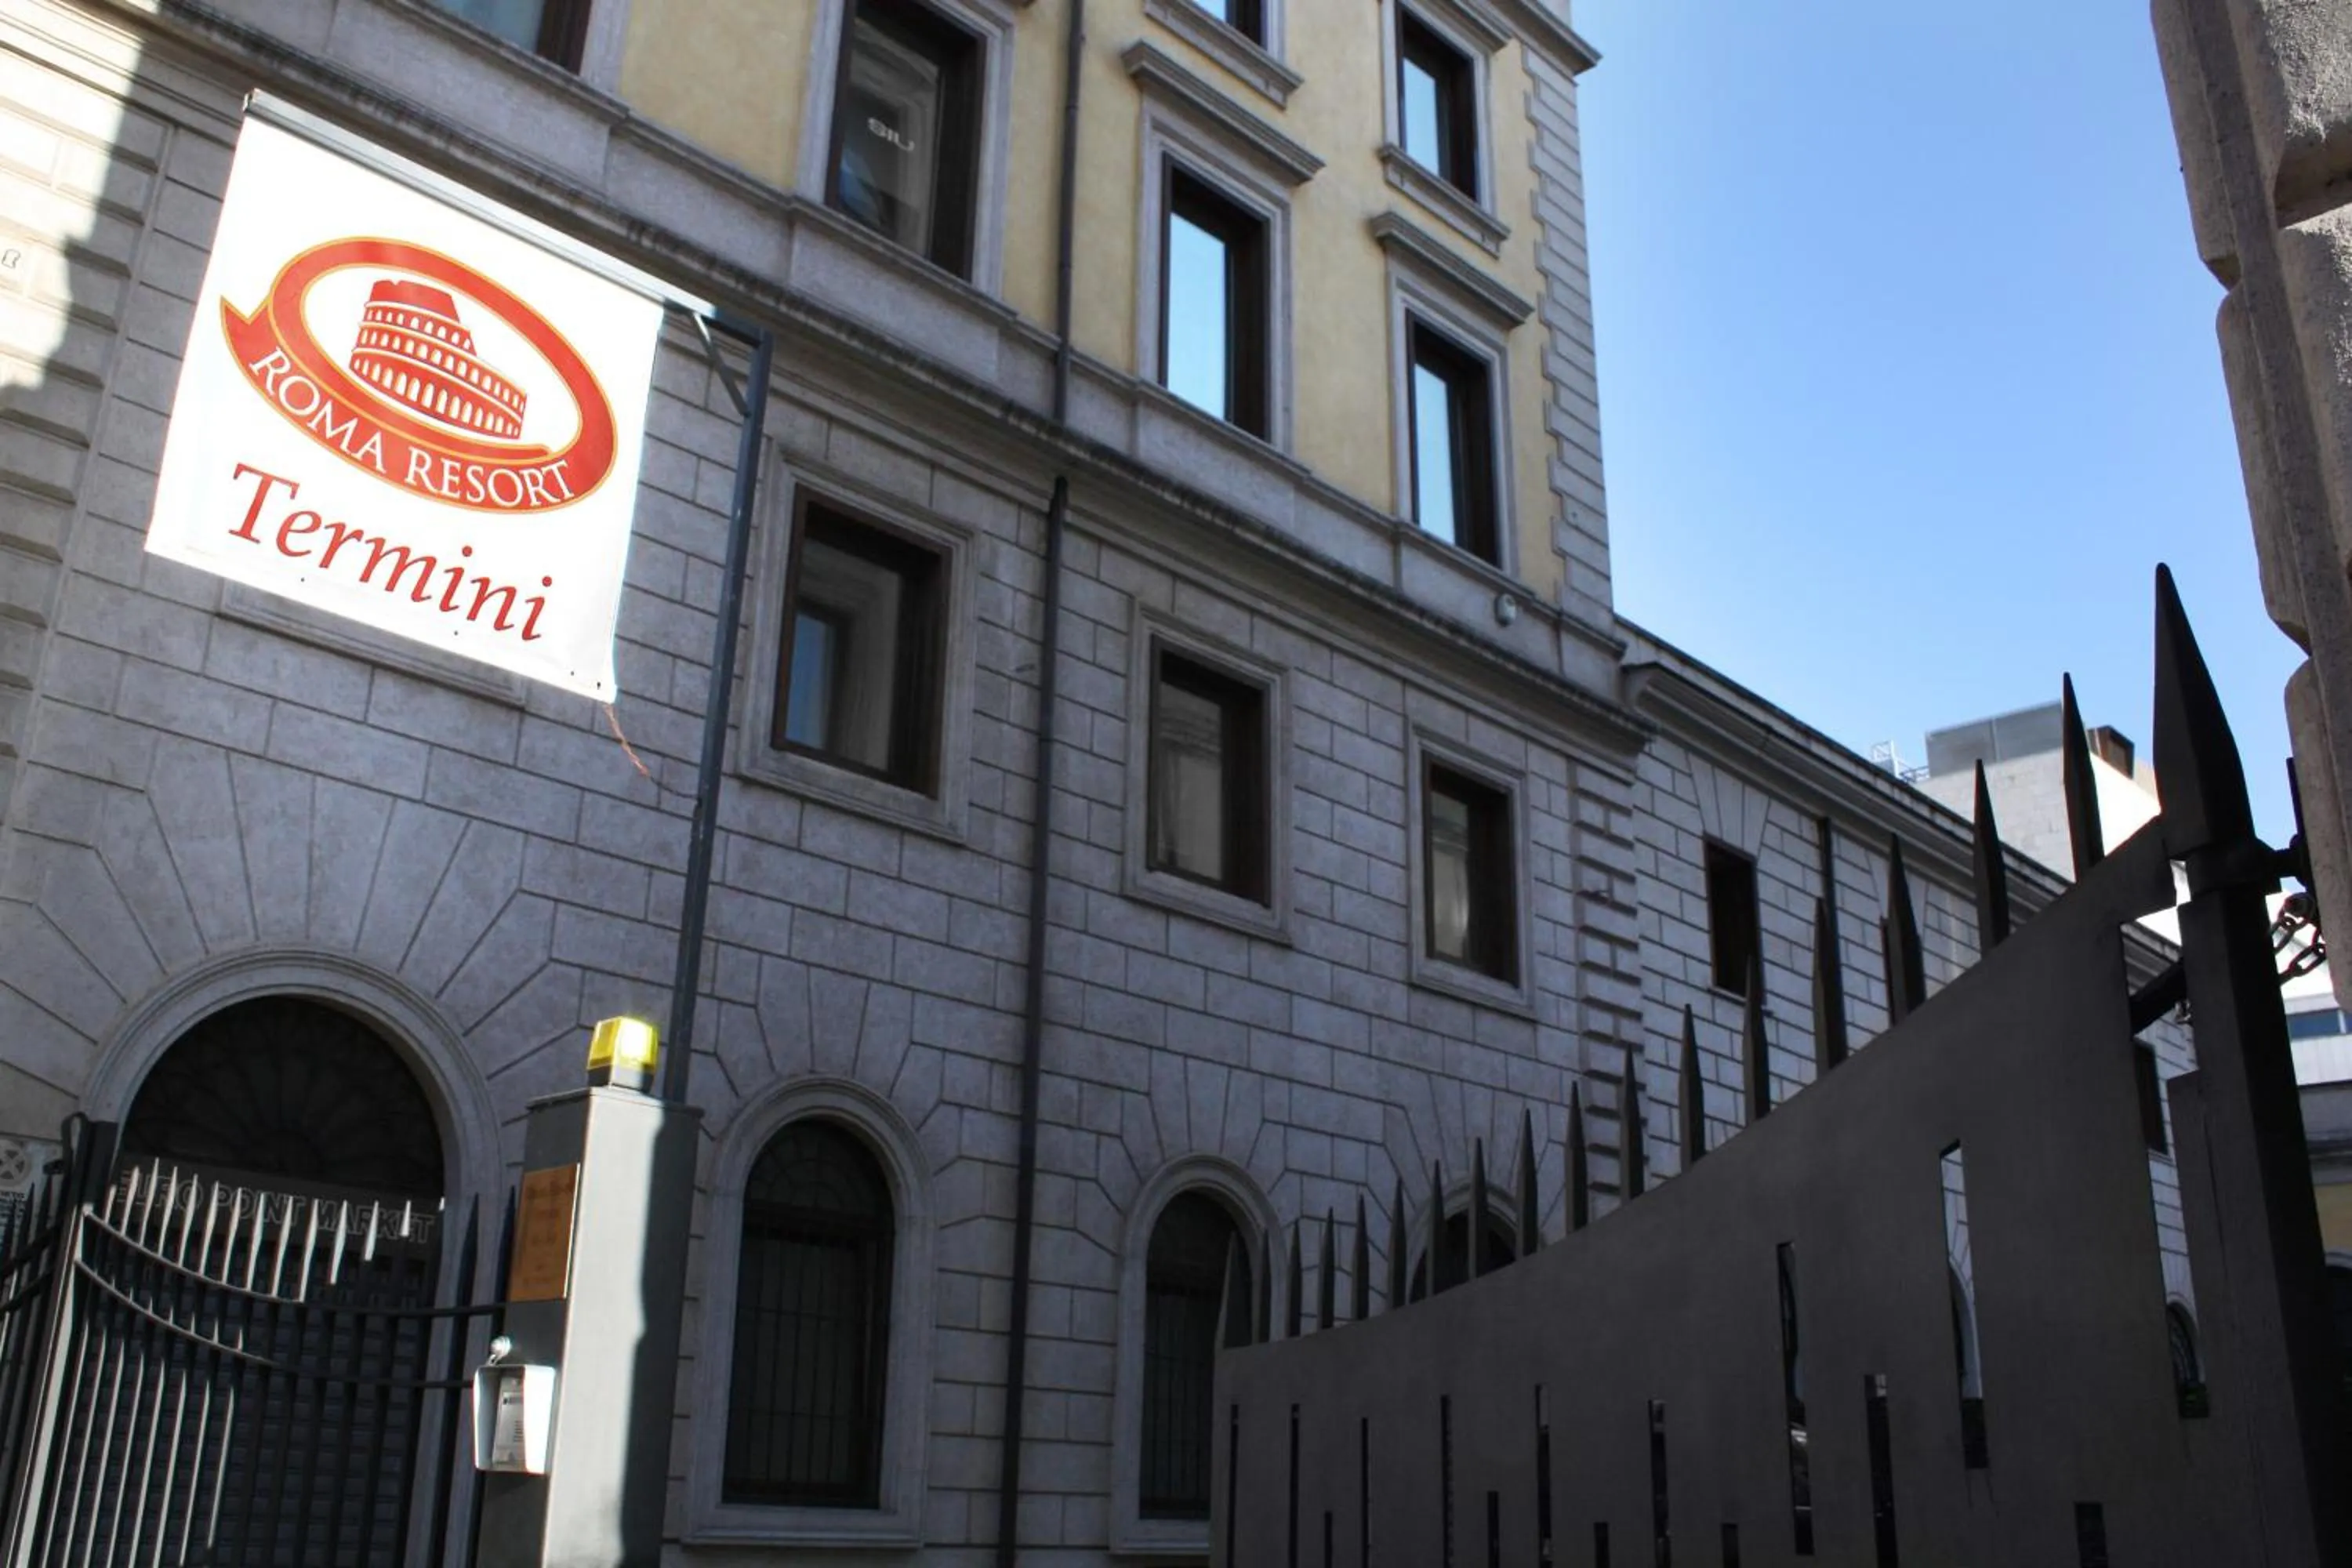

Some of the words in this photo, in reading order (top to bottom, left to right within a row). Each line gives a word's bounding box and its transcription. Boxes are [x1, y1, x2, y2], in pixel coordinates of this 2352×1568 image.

[250, 346, 387, 474] ROMA
[405, 445, 576, 508] RESORT
[228, 463, 553, 641] Termini
